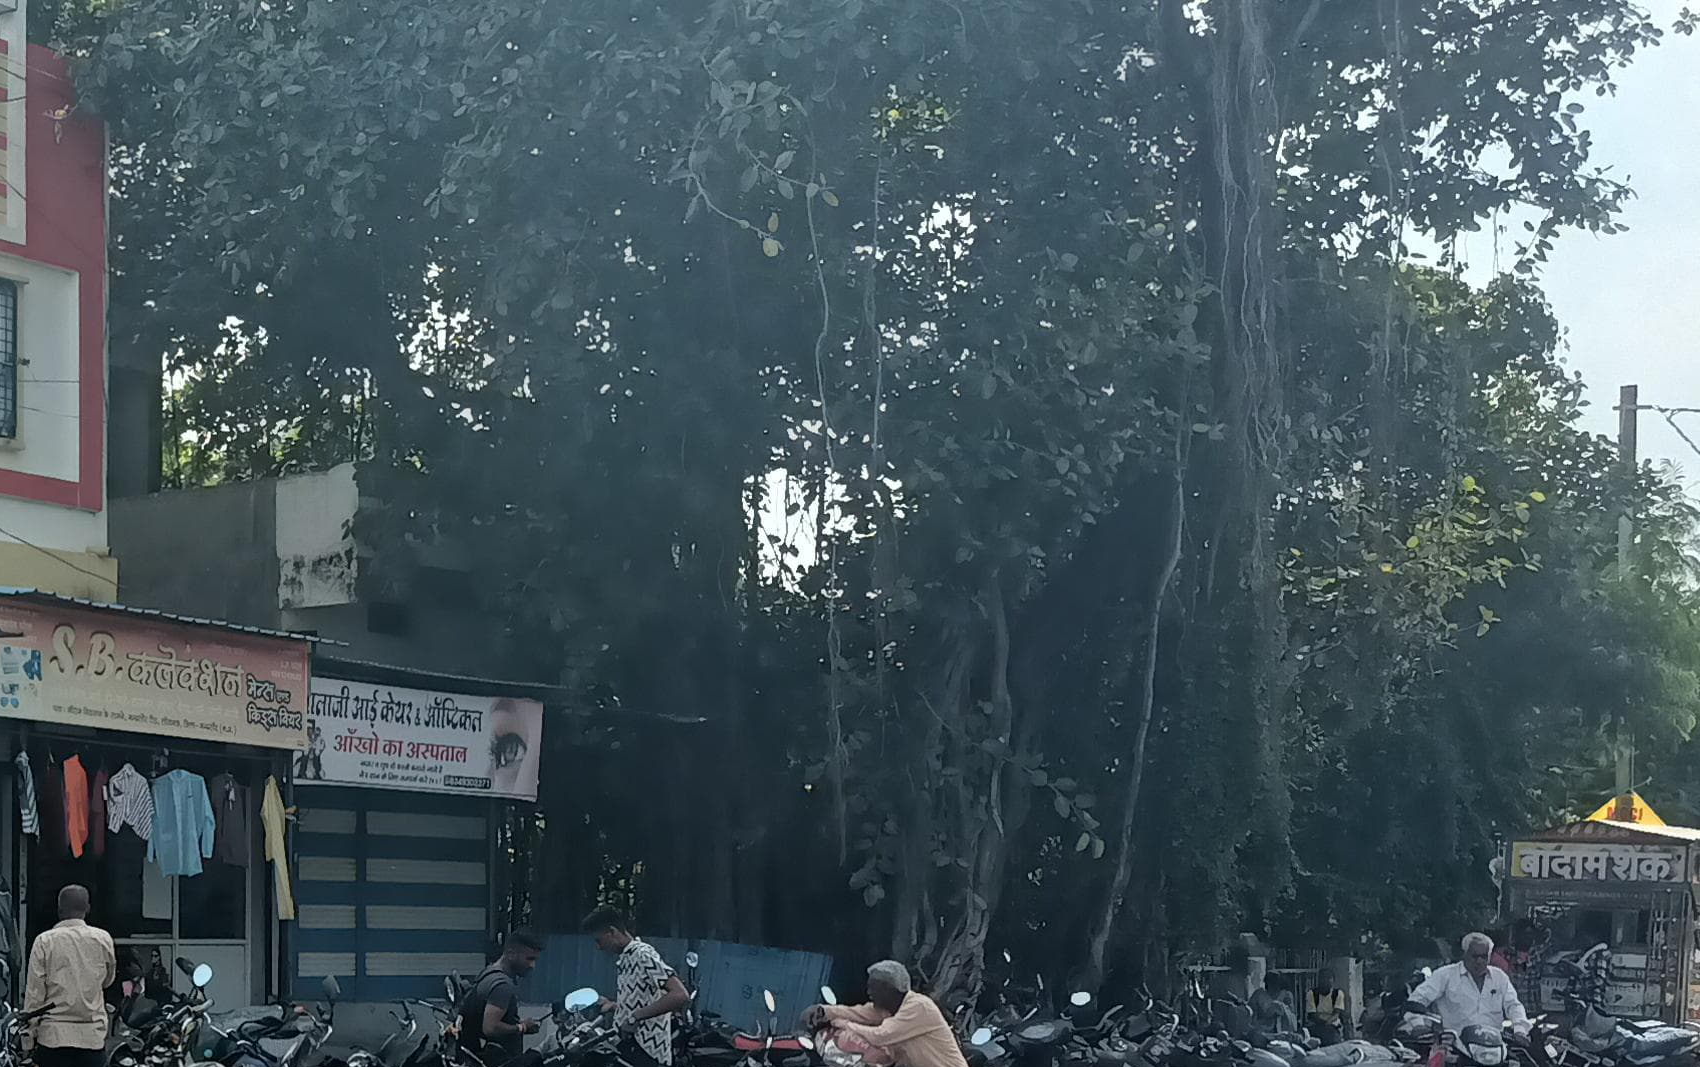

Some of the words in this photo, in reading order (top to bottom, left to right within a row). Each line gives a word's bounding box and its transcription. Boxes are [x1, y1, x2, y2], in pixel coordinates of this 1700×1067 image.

[308, 687, 348, 719] ालाजी
[351, 690, 378, 729] आई
[381, 693, 413, 726] केयर
[383, 740, 402, 758] का
[407, 742, 468, 763] अस्पताल
